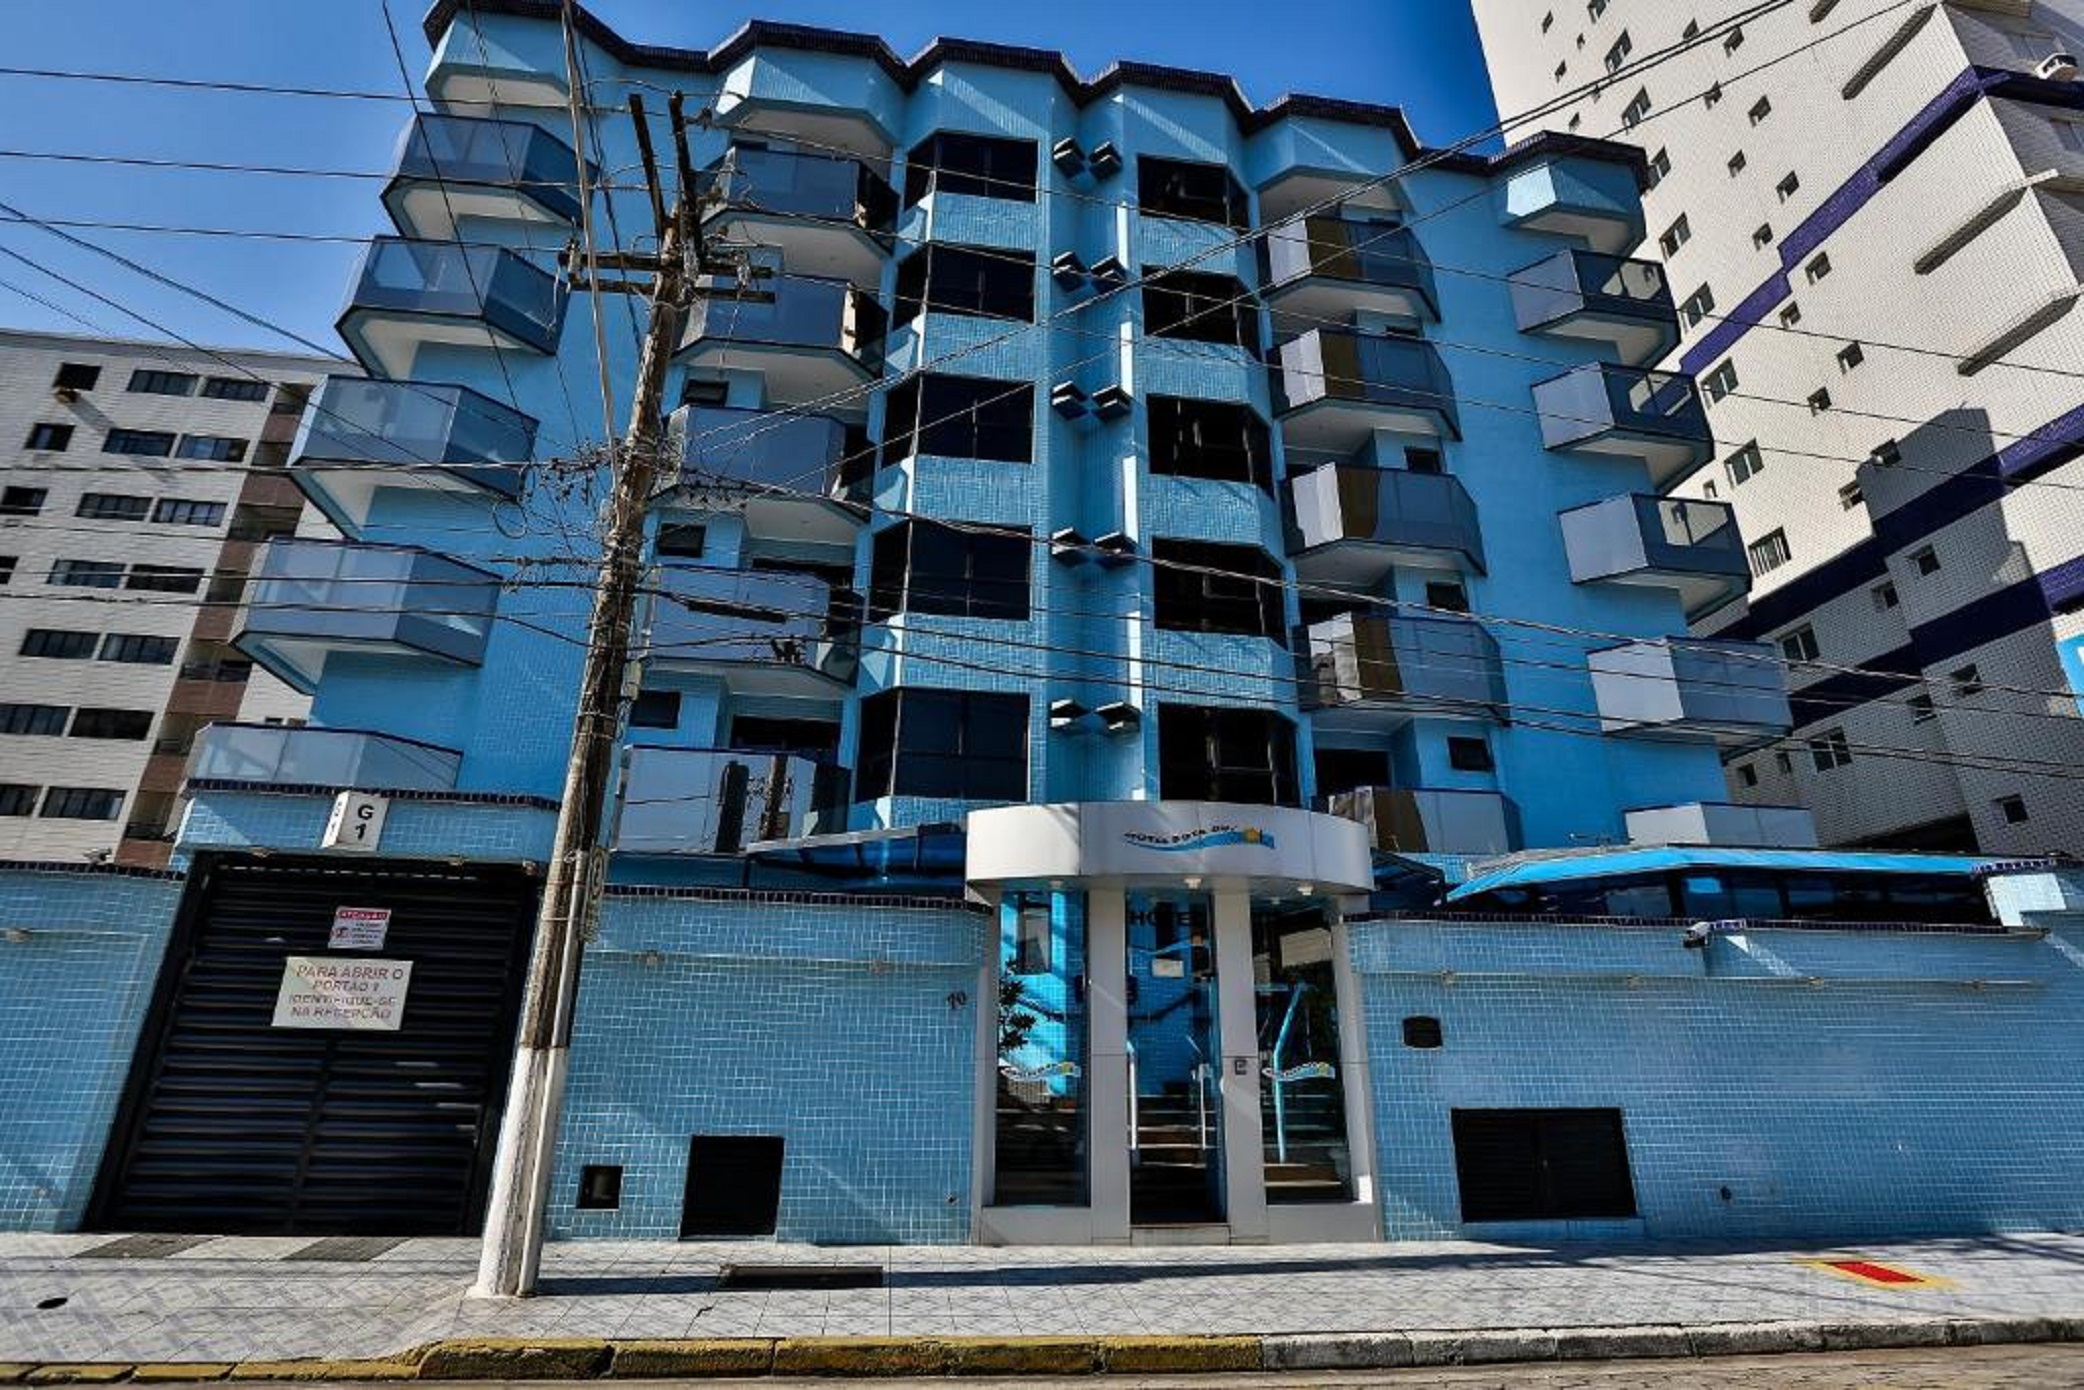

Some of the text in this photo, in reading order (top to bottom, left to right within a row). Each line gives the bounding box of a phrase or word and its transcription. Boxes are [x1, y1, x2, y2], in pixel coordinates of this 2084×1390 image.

[357, 804, 375, 820] G
[355, 822, 367, 841] 1
[296, 965, 404, 980] PARA ABRIR O
